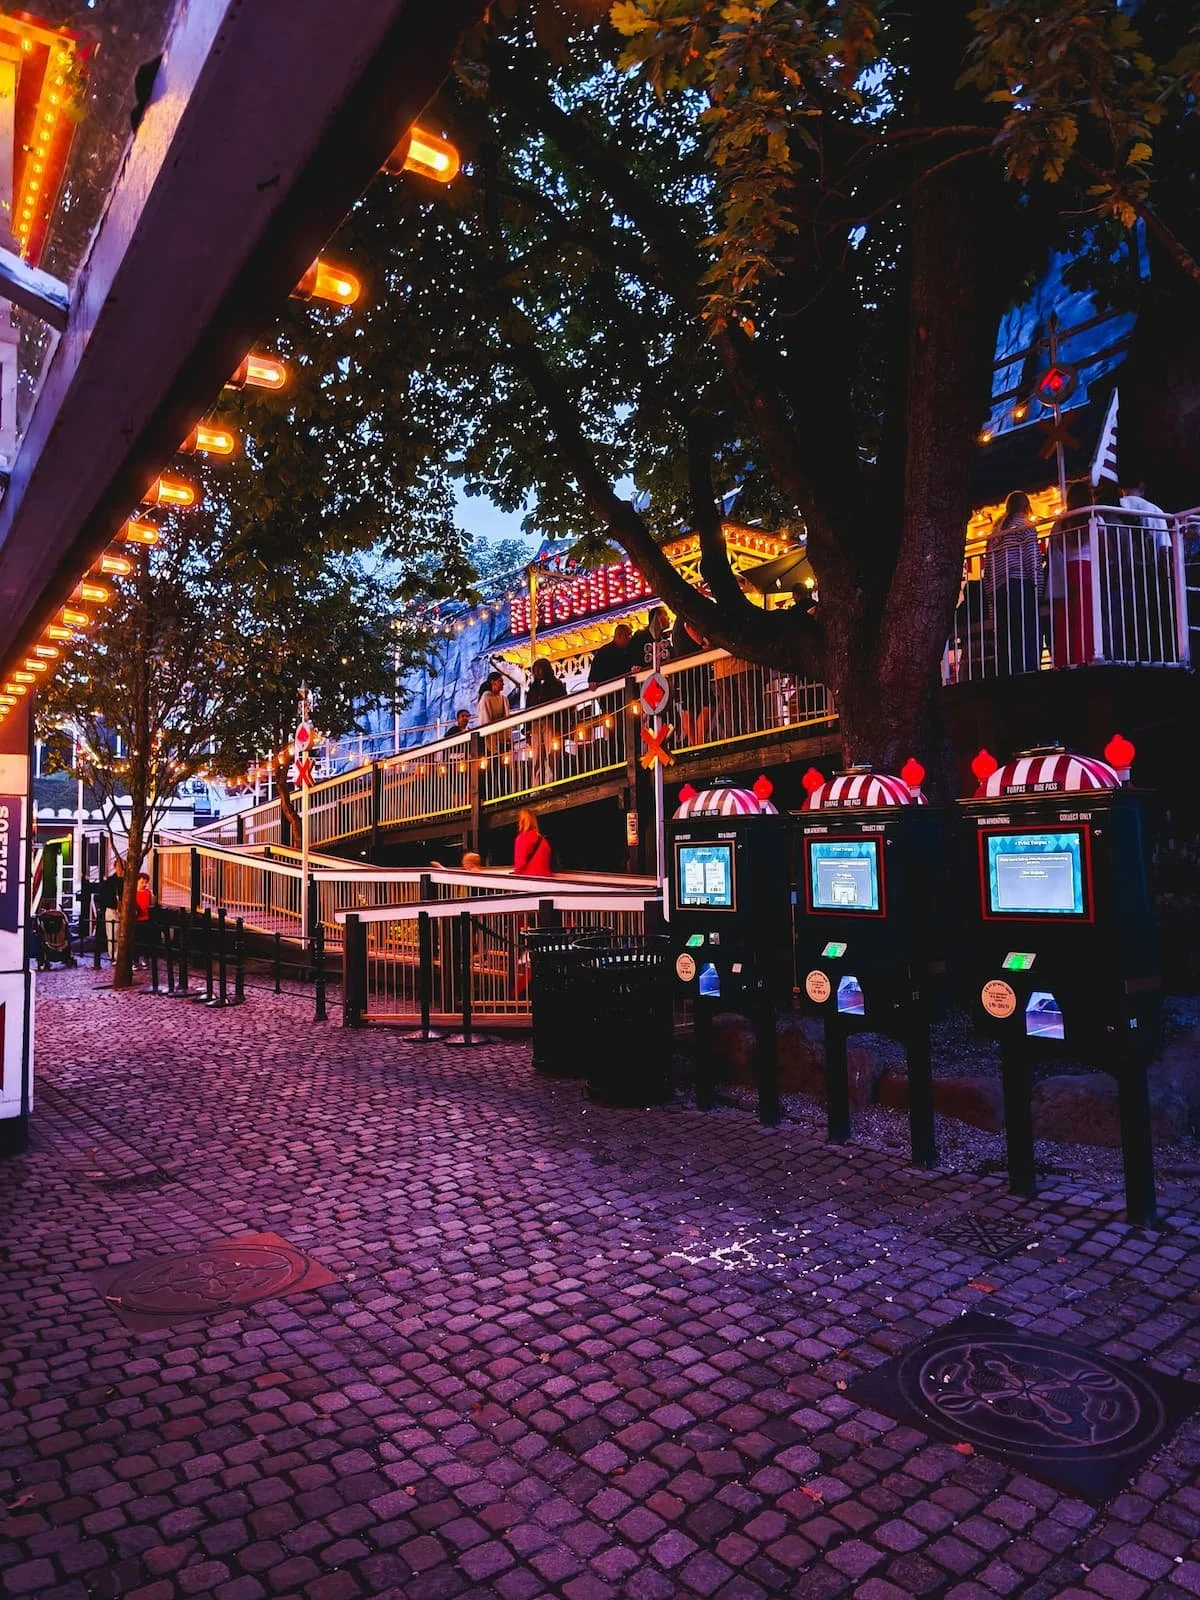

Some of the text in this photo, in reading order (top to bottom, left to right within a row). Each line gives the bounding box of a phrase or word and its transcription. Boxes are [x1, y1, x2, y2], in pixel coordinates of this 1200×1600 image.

[1045, 782, 1058, 791] PASS
[1059, 812, 1092, 822] COLLECT ONLY
